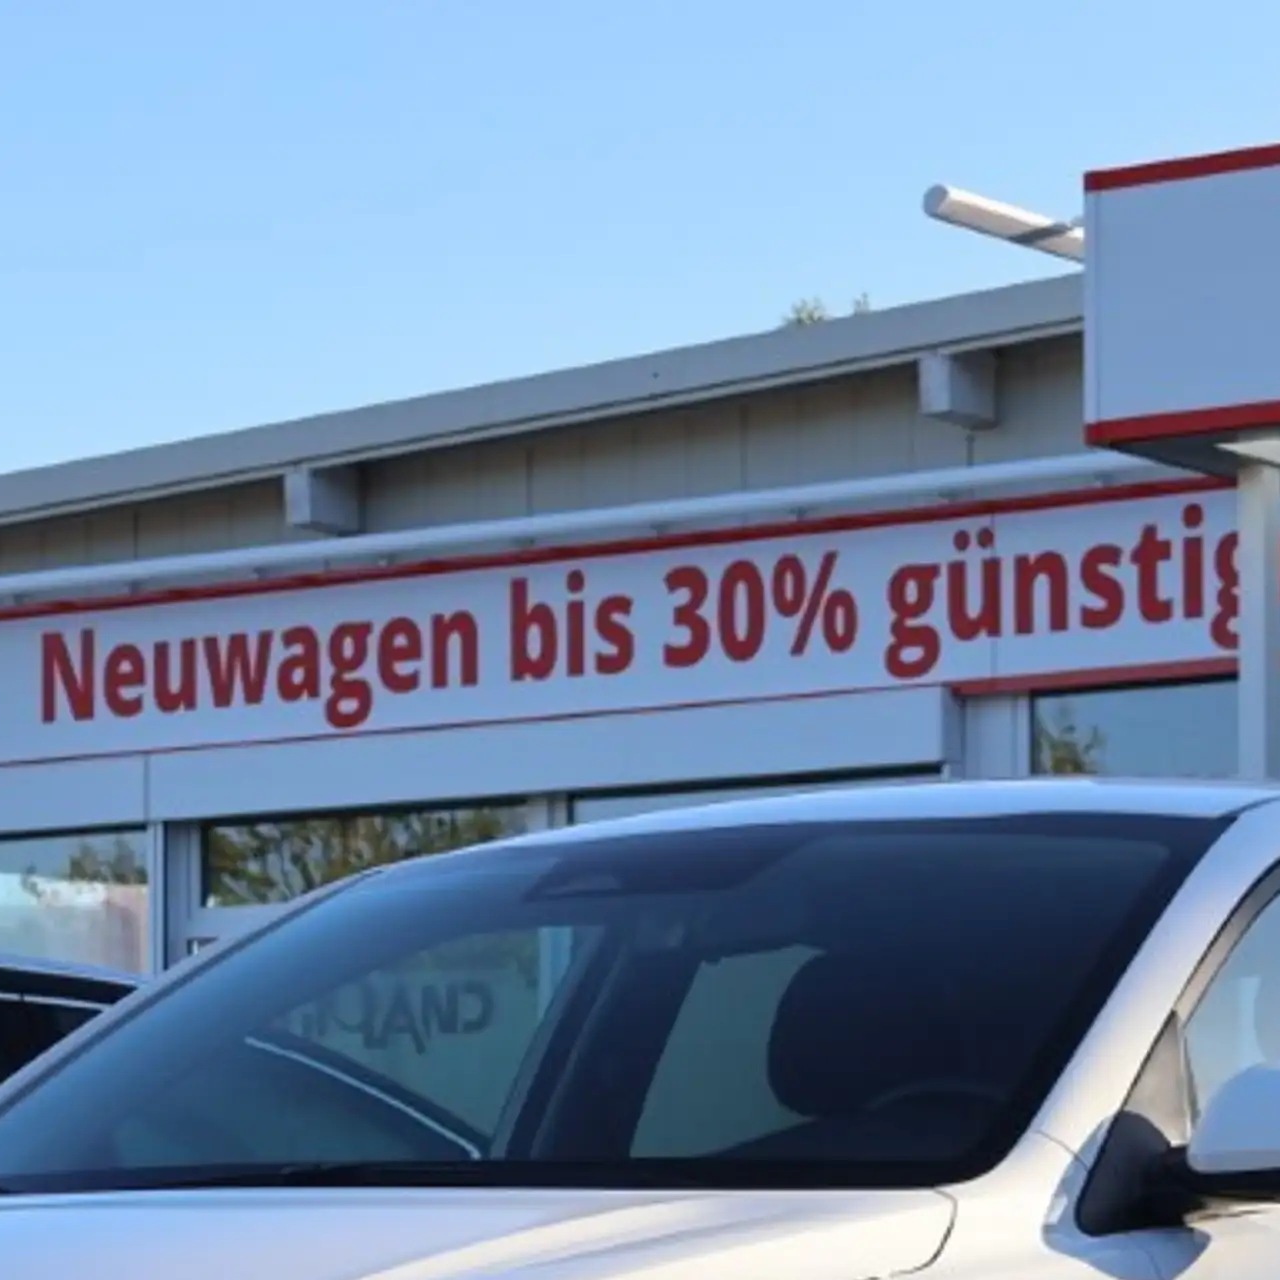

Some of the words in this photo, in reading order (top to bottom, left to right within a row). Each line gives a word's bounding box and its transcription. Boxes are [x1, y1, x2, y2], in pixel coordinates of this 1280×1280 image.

[40, 610, 479, 728] Neuwagen
[510, 569, 635, 683] bis
[663, 550, 858, 668] 30%
